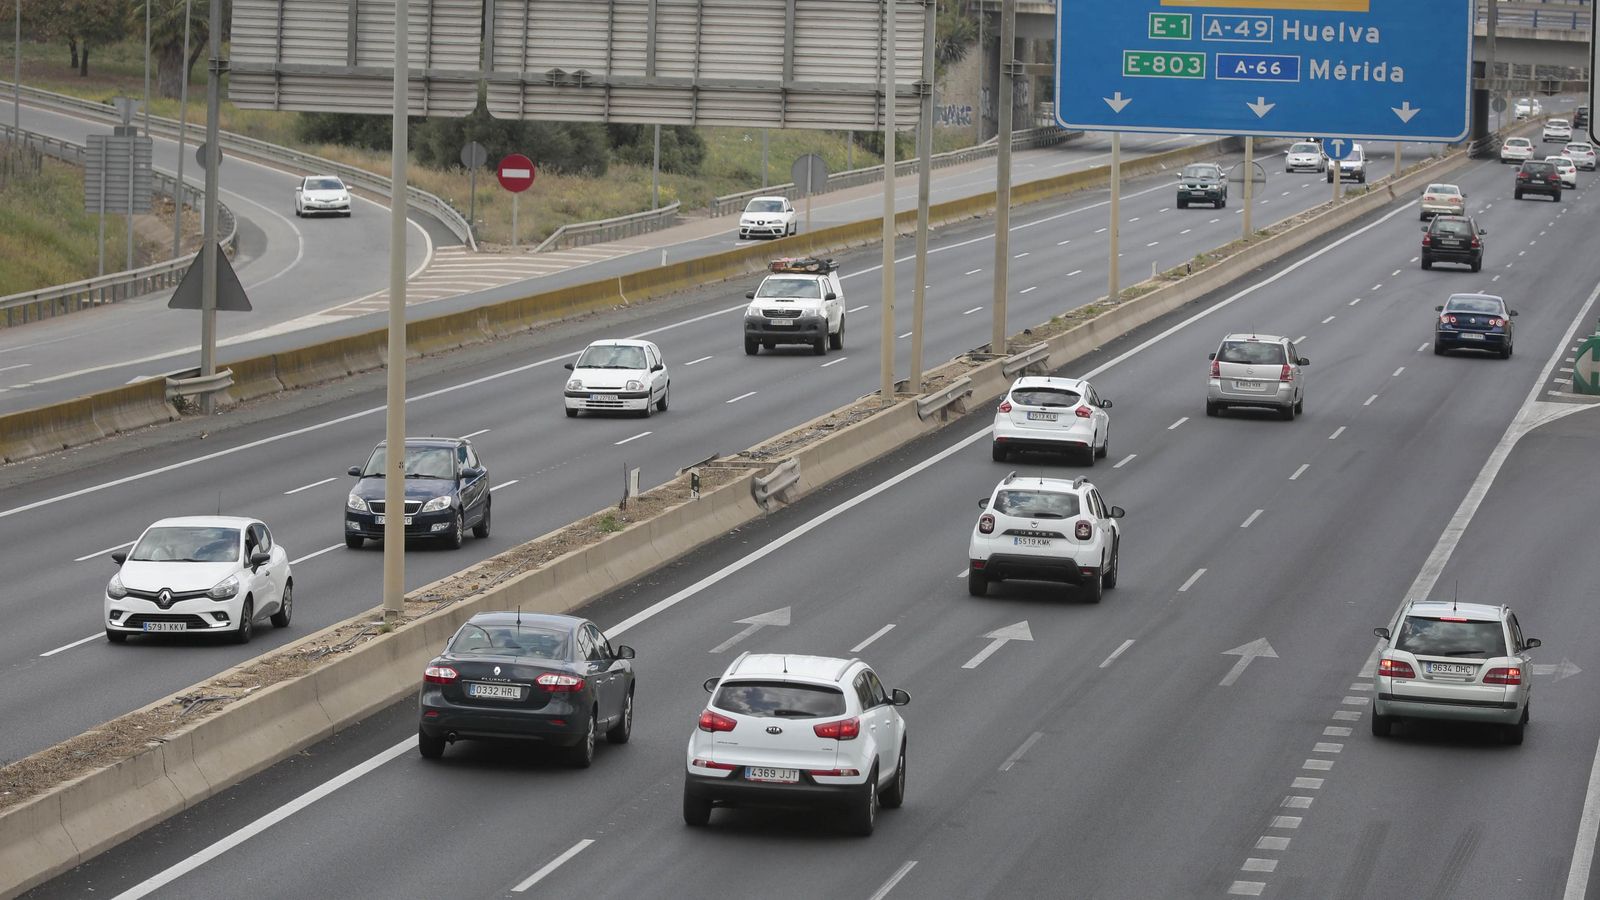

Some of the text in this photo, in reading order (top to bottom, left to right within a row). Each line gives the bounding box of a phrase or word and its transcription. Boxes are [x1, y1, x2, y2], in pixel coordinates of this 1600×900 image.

[1153, 17, 1380, 43] E-1 A-49 Huelva
[1127, 56, 1404, 82] E-803 A-66 Mérida
[1018, 537, 1036, 545] 5519
[147, 623, 185, 631] 5791 KKV
[1432, 664, 1471, 674] 9634 DHC
[476, 685, 518, 697] 0332 HRL
[751, 768, 797, 779] 4369 JJT
